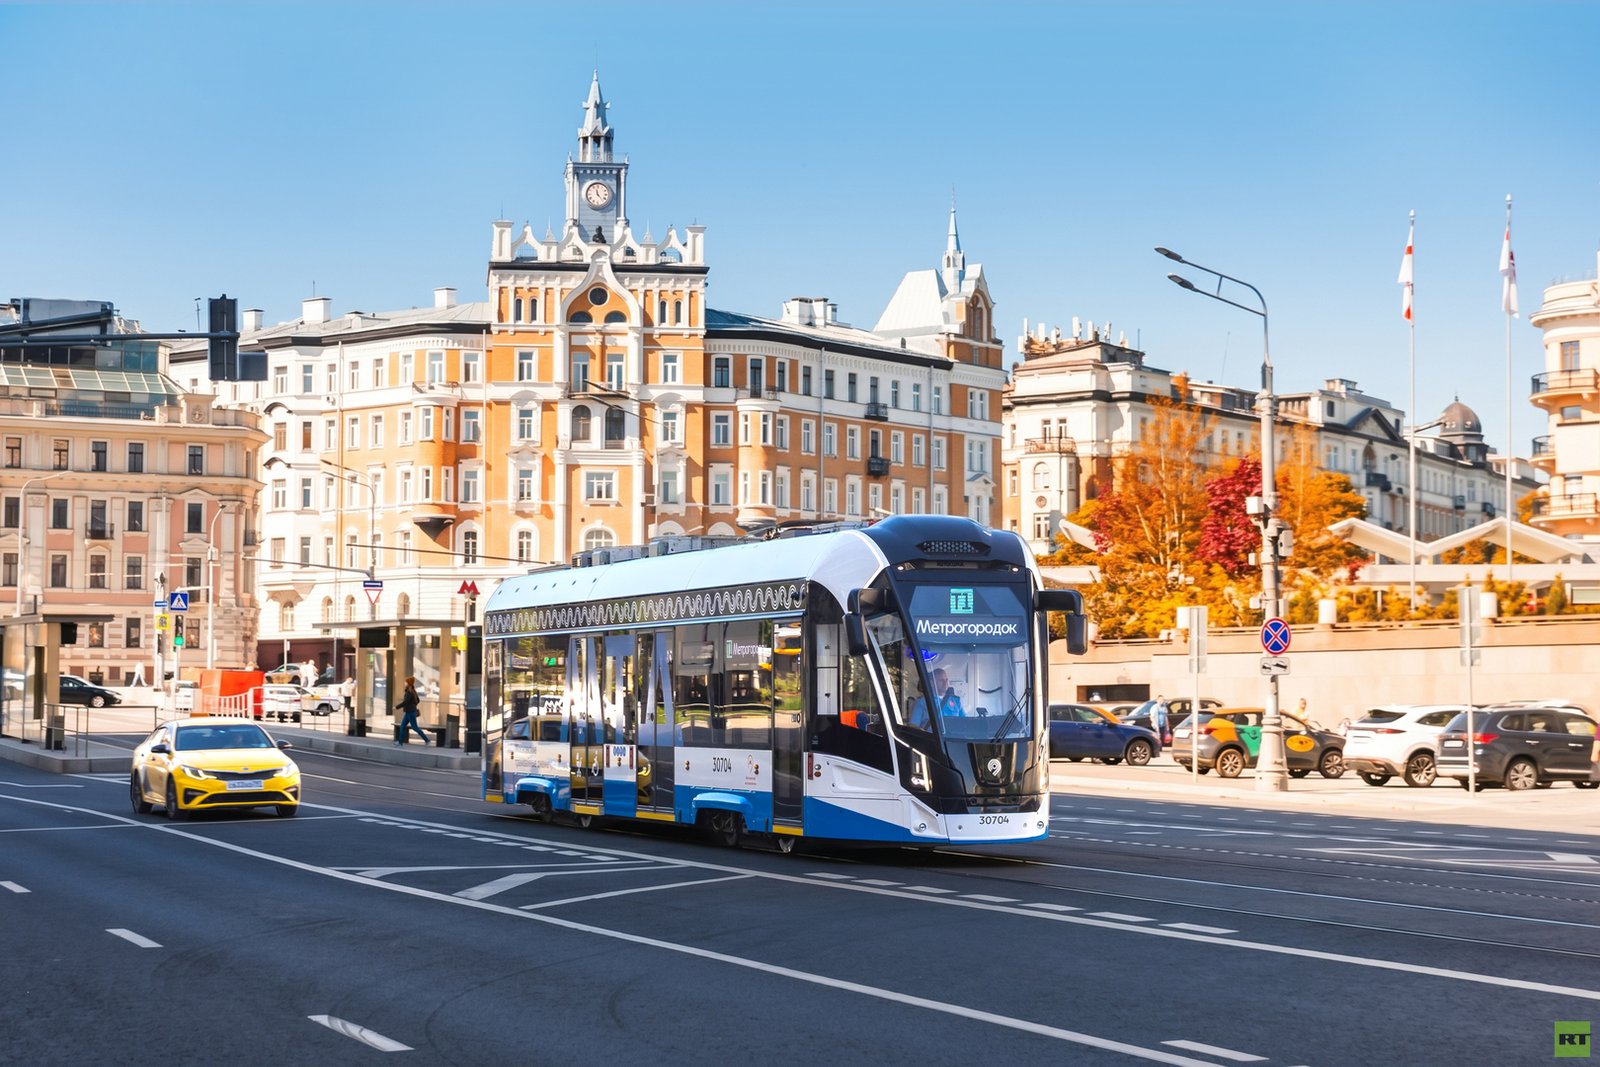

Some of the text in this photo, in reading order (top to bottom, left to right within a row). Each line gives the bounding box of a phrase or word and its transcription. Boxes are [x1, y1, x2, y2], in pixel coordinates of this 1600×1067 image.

[916, 619, 1018, 636] Метрогородок
[712, 757, 732, 773] 30704
[979, 815, 1009, 825] 30704
